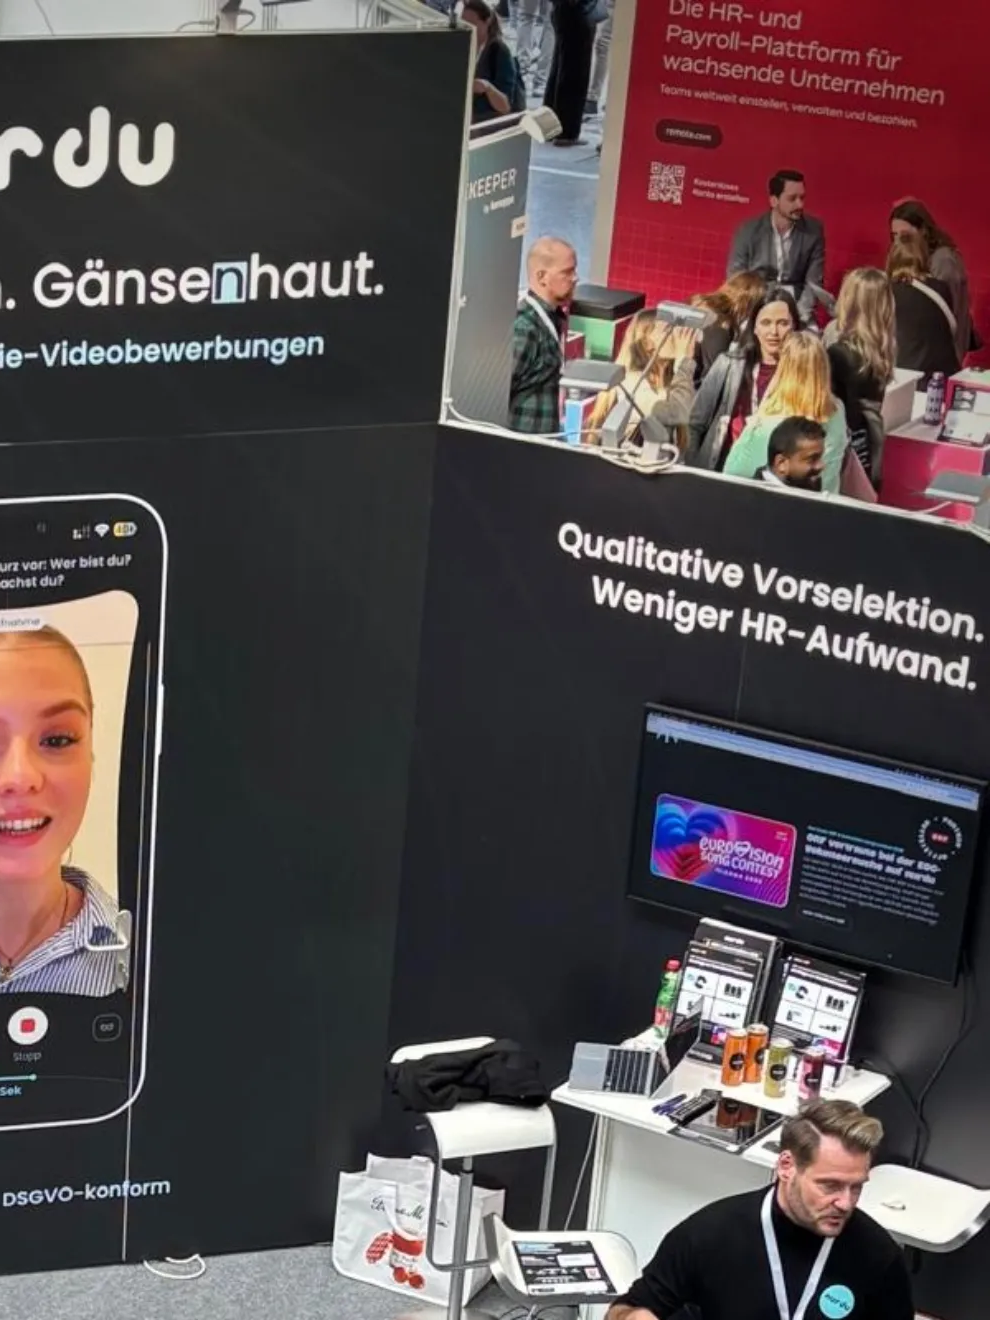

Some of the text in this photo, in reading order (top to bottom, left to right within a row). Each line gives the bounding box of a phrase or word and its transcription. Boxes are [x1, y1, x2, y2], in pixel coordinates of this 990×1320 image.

[669, 0, 803, 30] Die HR- und
[666, 24, 903, 71] Payroll-Plattform für
[663, 54, 945, 106] wachsende Unternehmen
[845, 109, 865, 121] und
[32, 251, 385, 309] Gänsenhaut.
[40, 573, 65, 588] du?
[50, 556, 77, 570] Wer
[79, 554, 104, 569] bist
[107, 553, 133, 567] du?
[557, 522, 985, 643] Qualitative Vorselektion.
[592, 576, 978, 691] Weniger HR-Aufwand.
[3, 1178, 171, 1208] DSGVO-konform
